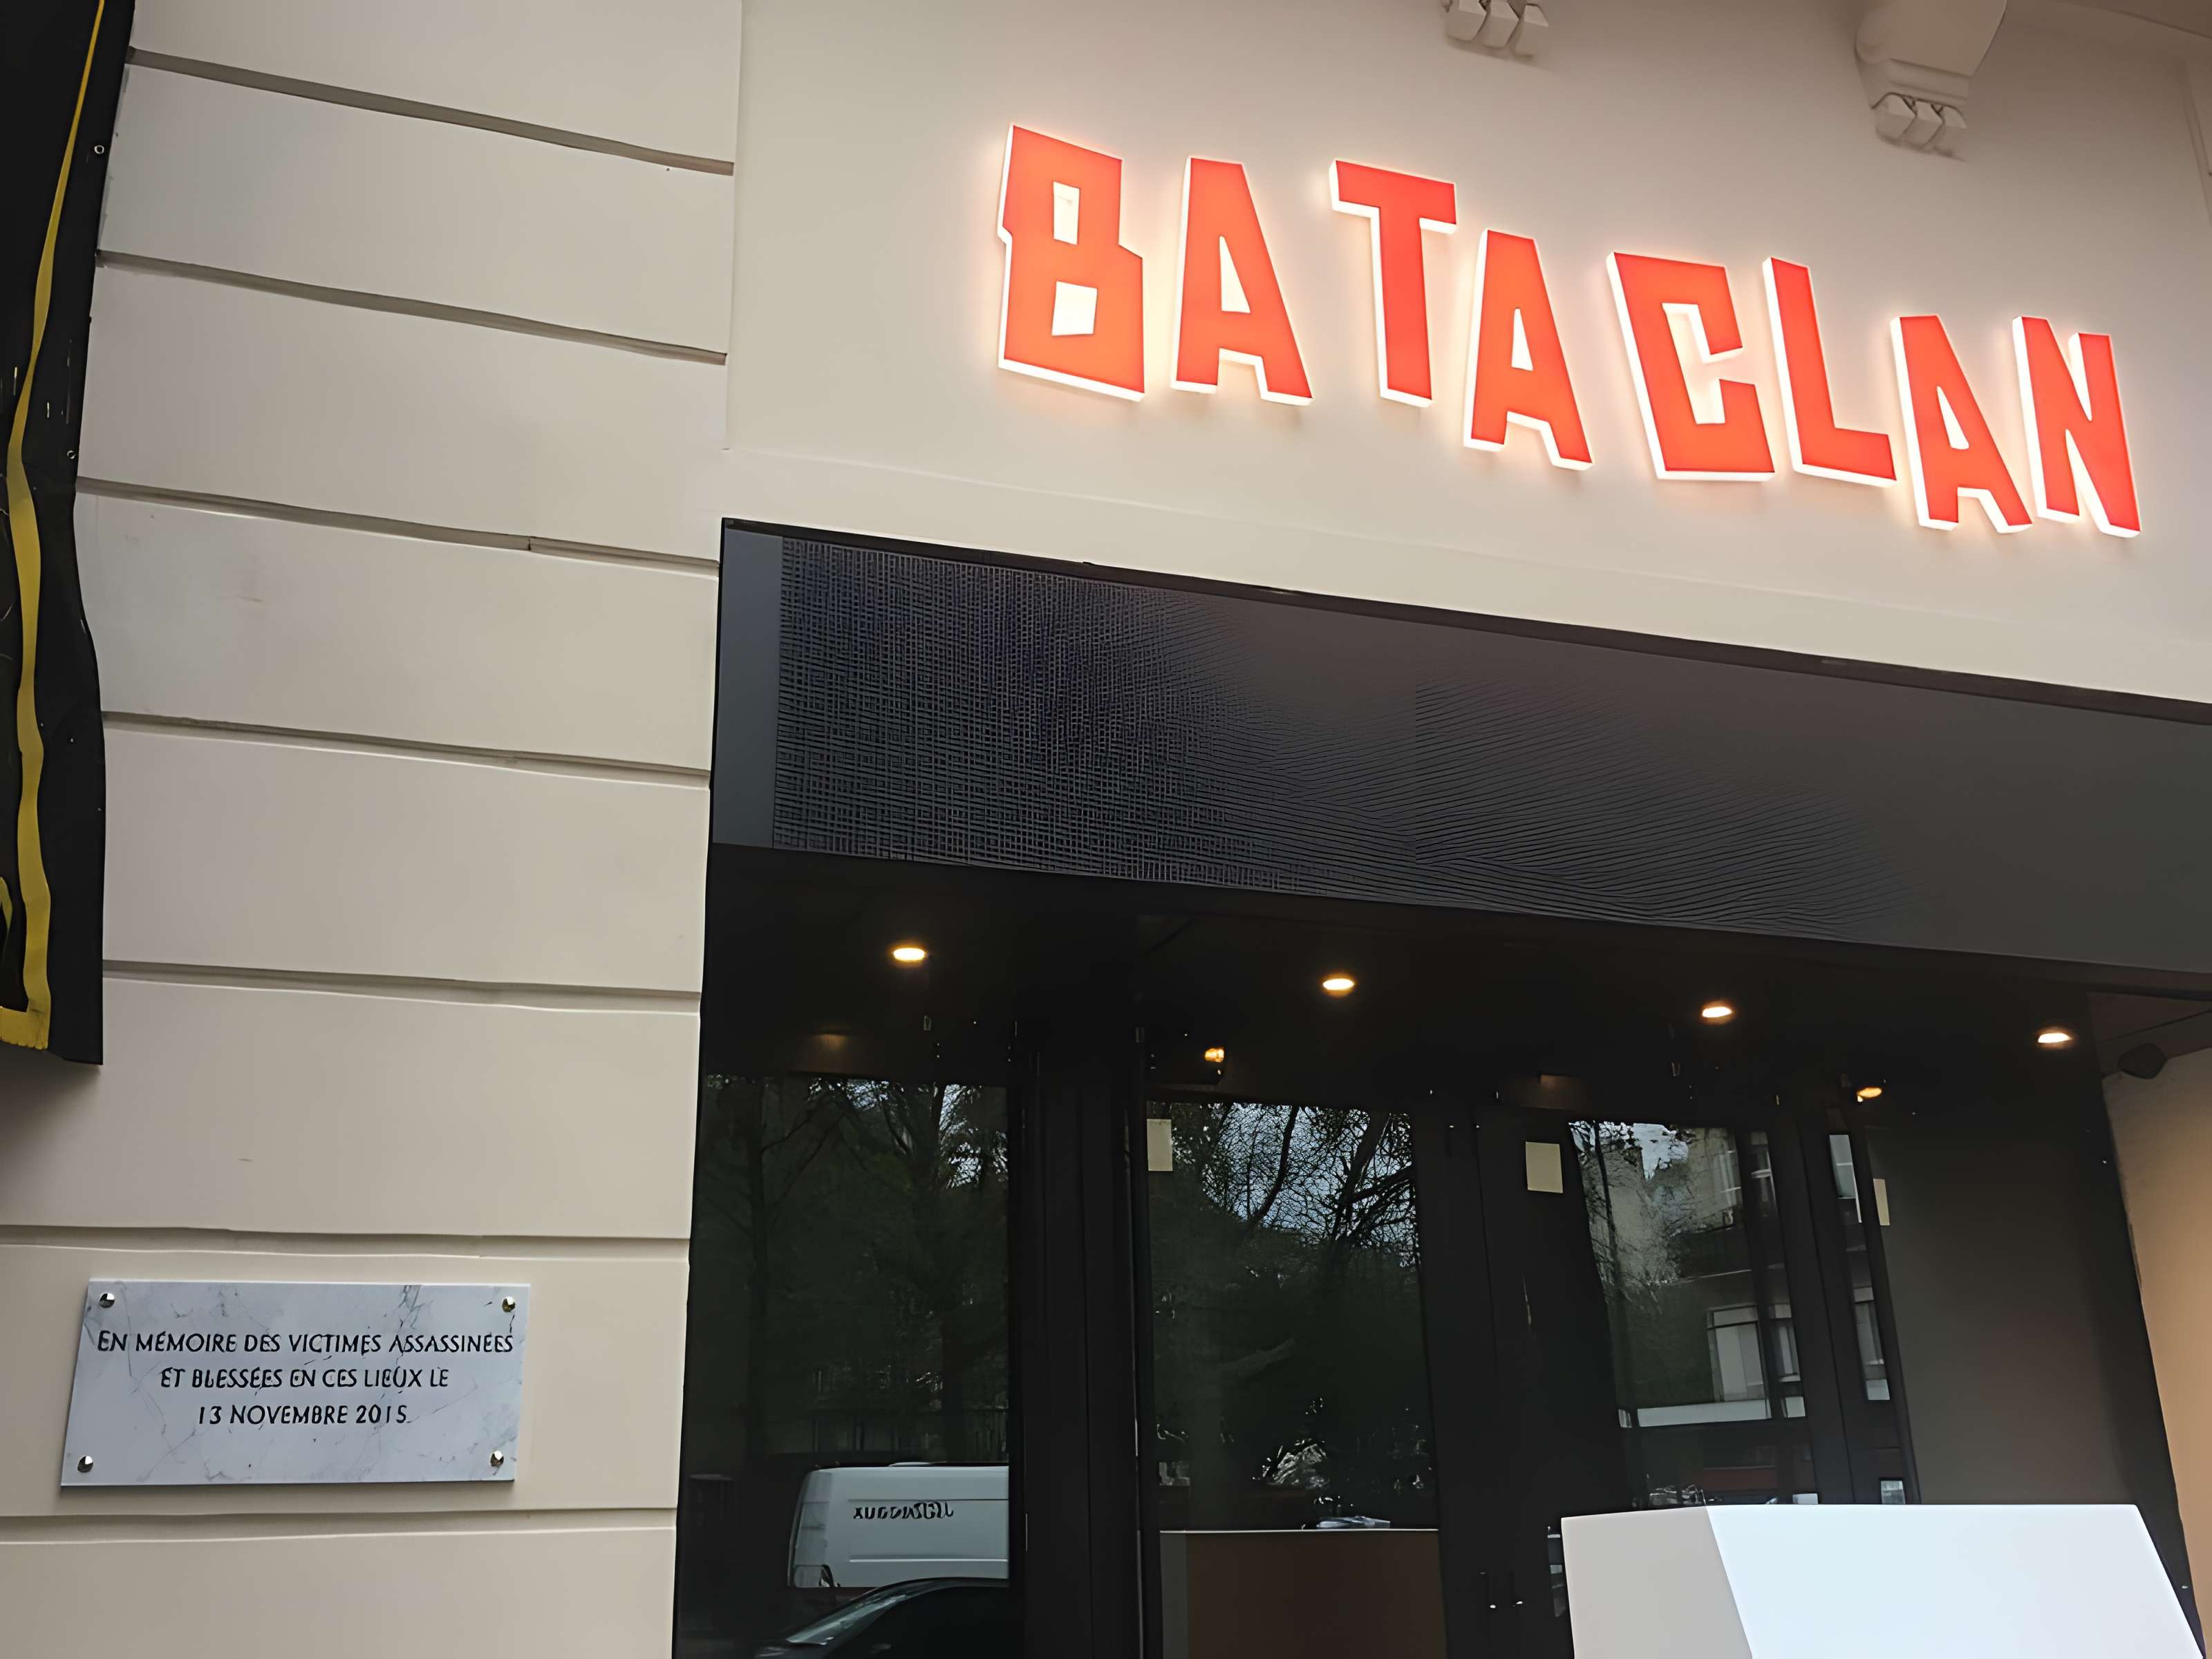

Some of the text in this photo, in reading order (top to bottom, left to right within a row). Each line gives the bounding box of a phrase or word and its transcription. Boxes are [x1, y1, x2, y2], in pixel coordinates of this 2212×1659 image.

[995, 122, 2142, 538] BATACLAN
[135, 1331, 237, 1353] MÉMOIRE
[244, 1333, 281, 1353] DES
[288, 1333, 382, 1355] VICTIMES
[160, 1367, 186, 1388] ET
[290, 1369, 316, 1387] EN
[322, 1369, 357, 1387] CES
[364, 1366, 423, 1387] LIEUX
[430, 1368, 449, 1387] LE
[199, 1404, 409, 1425] 13 NOVEMBRE 2015
